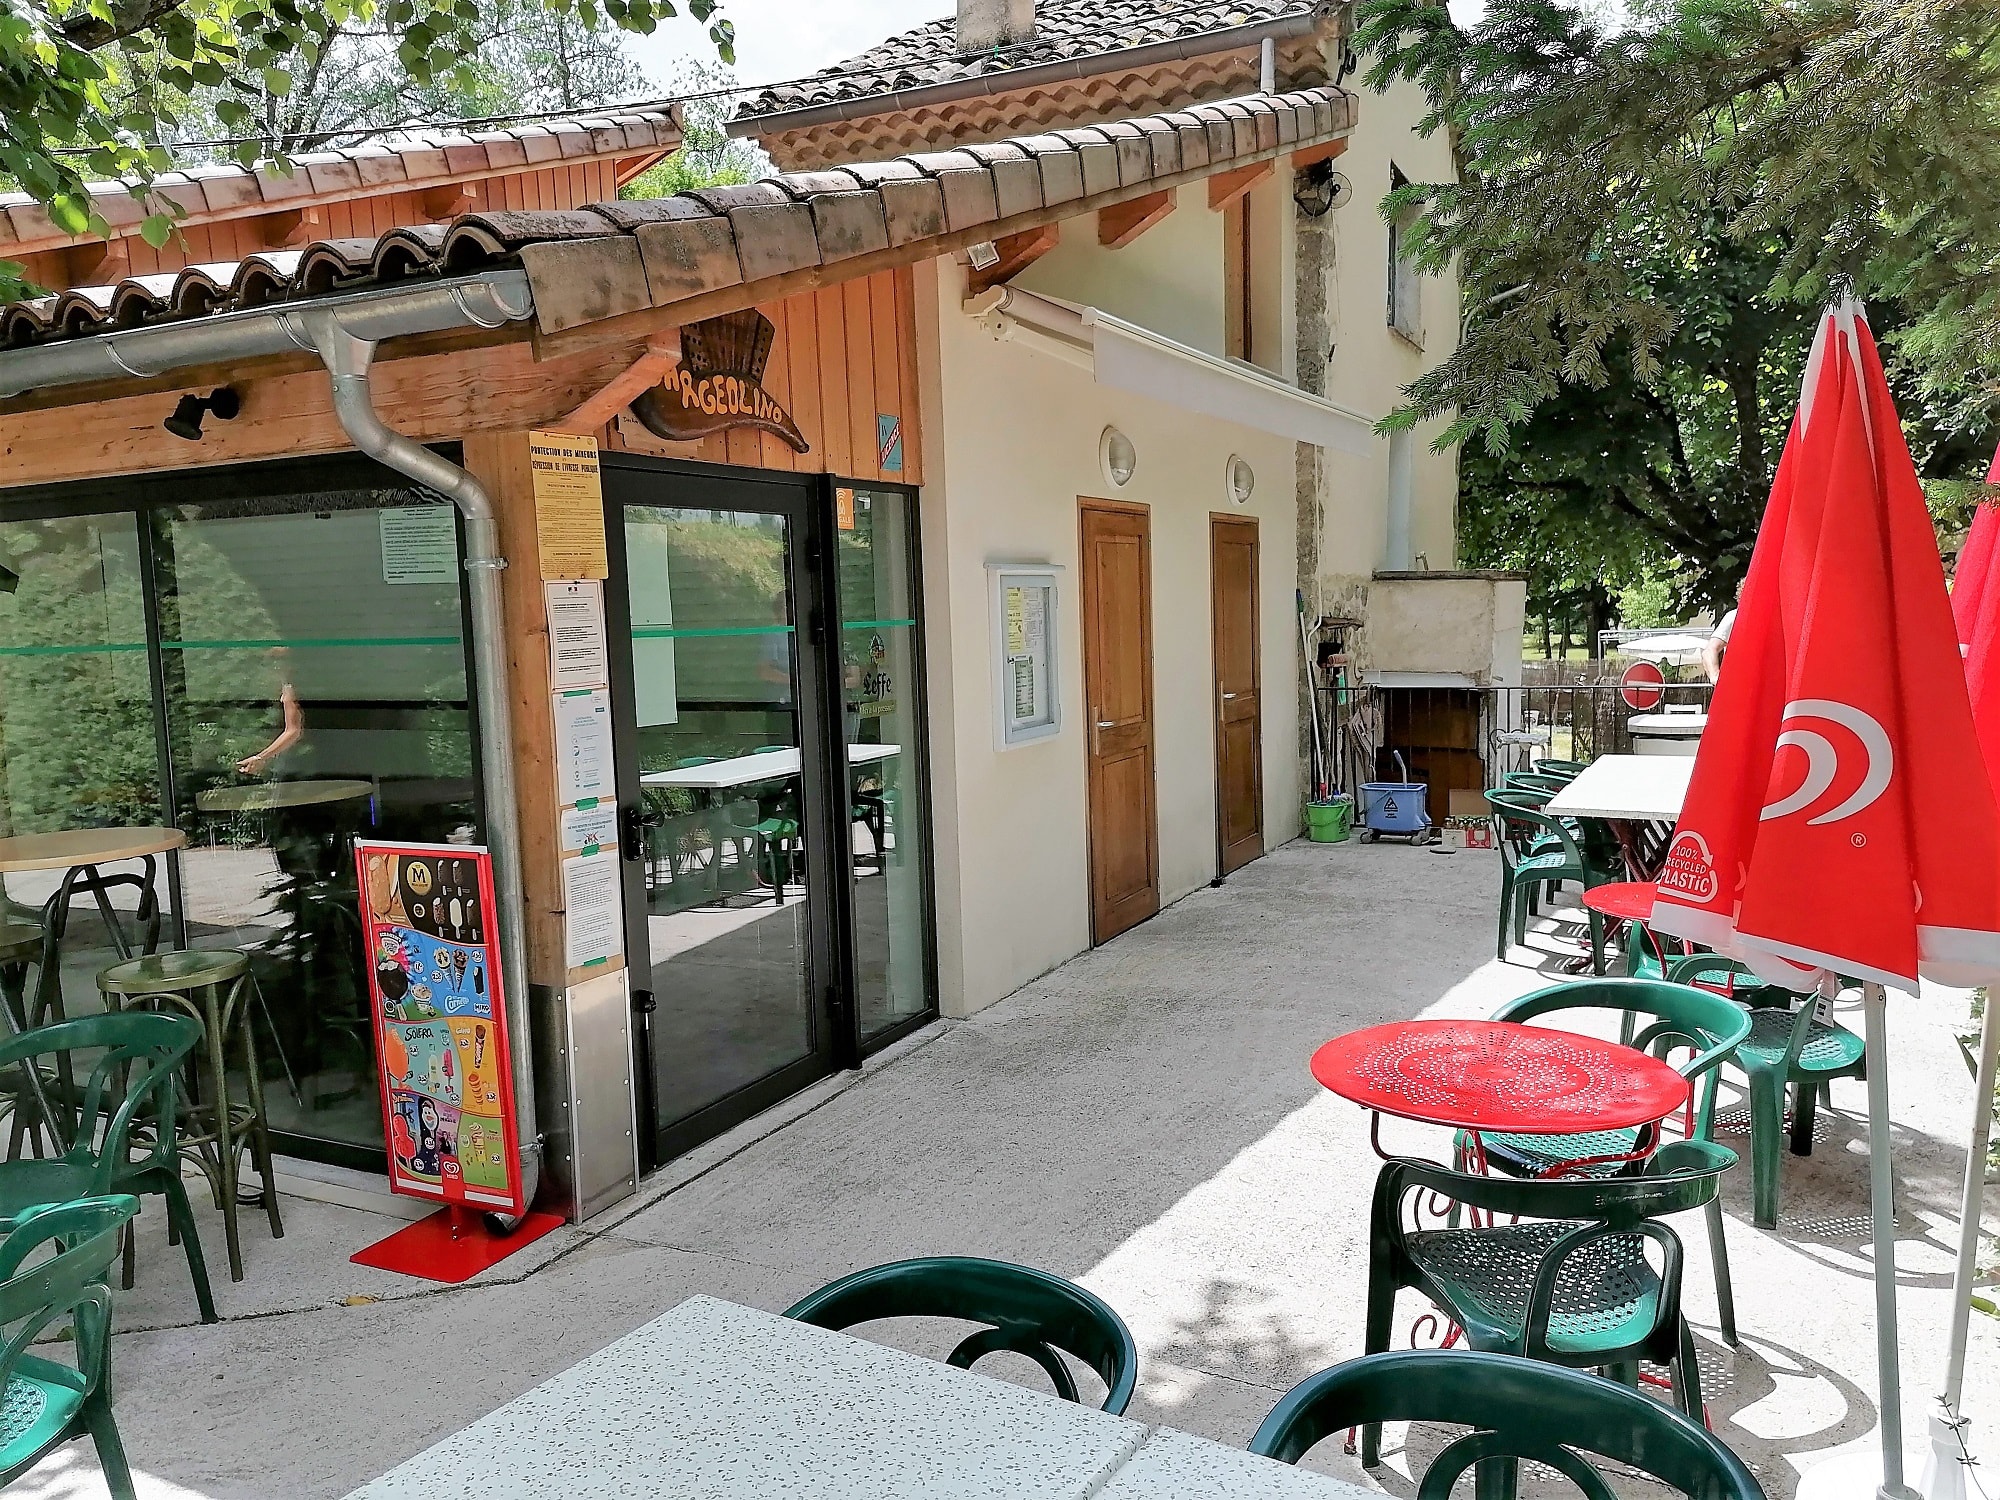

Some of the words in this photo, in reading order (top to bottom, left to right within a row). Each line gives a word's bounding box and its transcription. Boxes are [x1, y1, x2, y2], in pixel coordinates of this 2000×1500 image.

[863, 672, 892, 700] Leffe
[1675, 845, 1698, 860] 100%
[1665, 856, 1706, 874] RECYCLED
